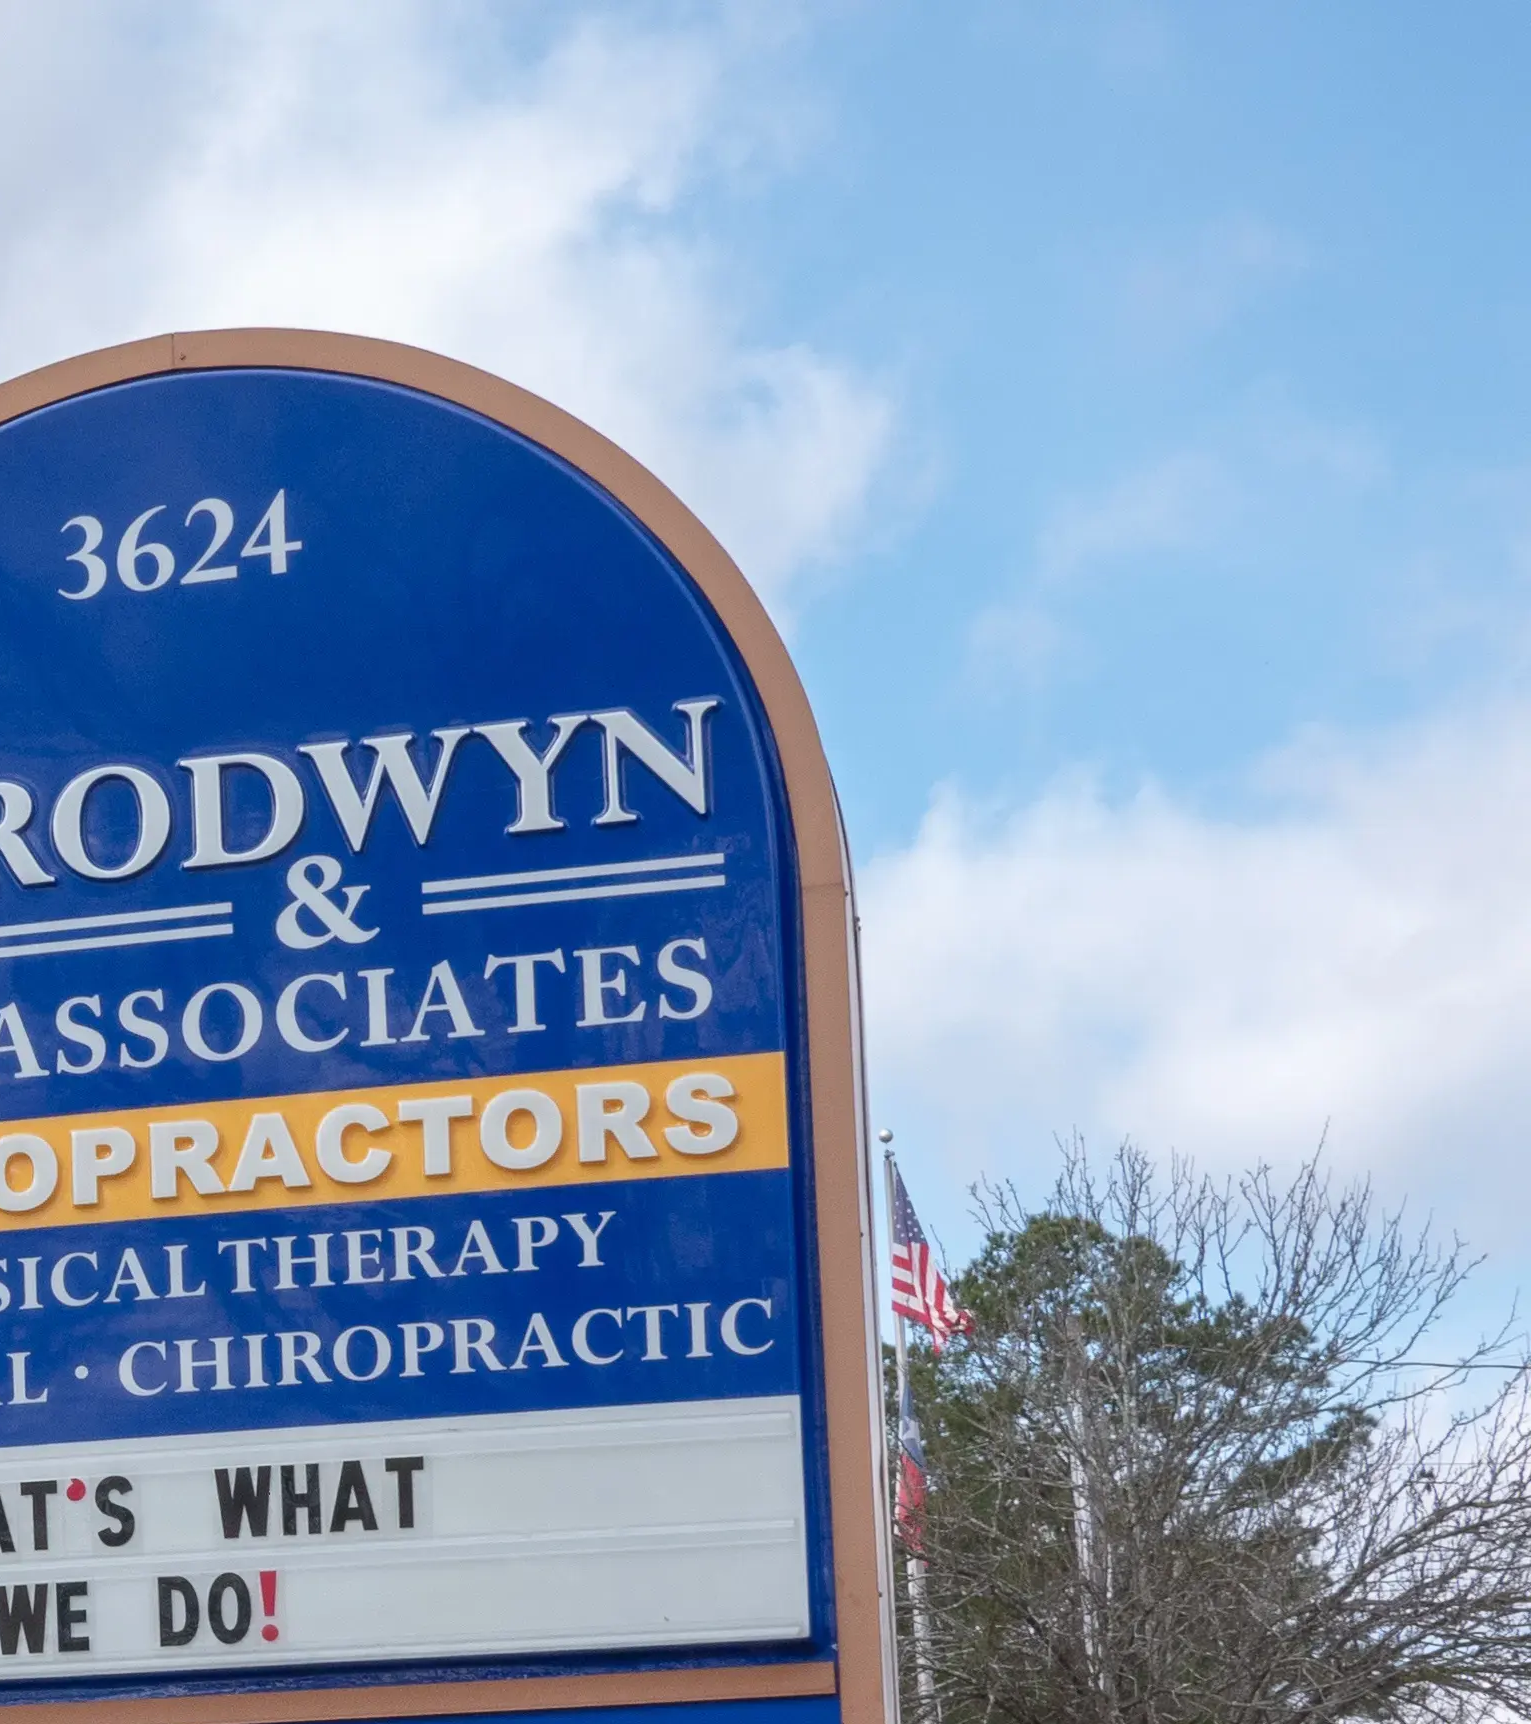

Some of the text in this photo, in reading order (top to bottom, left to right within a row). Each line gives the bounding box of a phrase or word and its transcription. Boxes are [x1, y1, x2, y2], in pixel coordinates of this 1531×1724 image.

[58, 488, 303, 601] 3624
[274, 852, 381, 951] &
[217, 1210, 617, 1299] THERAPY
[116, 1297, 775, 1398] CHIROPRACTIC
[213, 1455, 425, 1540] WHAT
[156, 1568, 282, 1648] DO!
